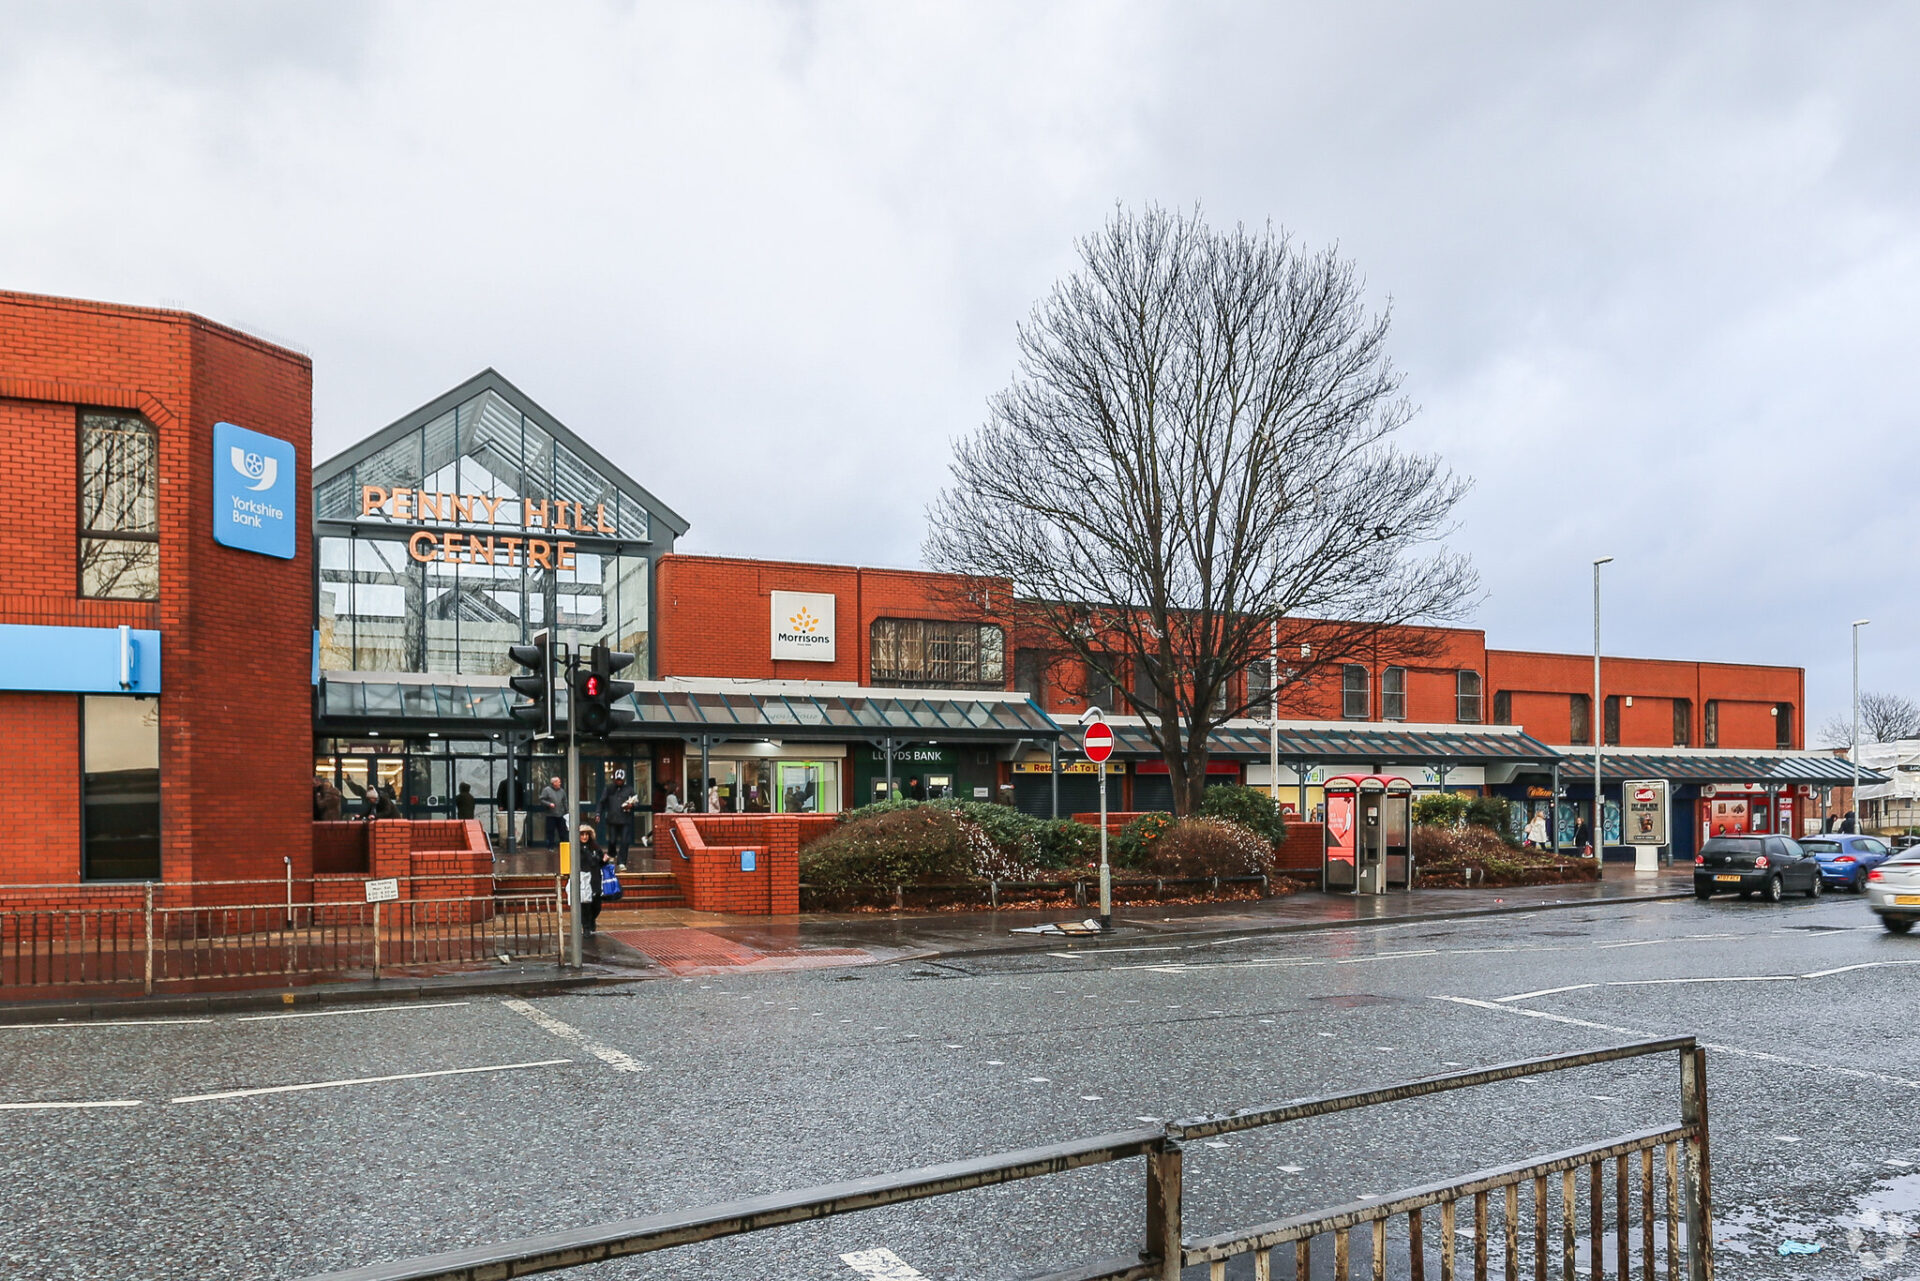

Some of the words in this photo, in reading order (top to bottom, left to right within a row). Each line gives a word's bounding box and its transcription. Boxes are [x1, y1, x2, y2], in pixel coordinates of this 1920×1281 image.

[231, 495, 283, 520] Yorkshire
[362, 485, 503, 525] PENNY
[525, 498, 616, 534] HILL
[232, 509, 263, 529] Bank
[409, 530, 577, 571] CENTRE
[778, 632, 830, 644] Morrisons
[872, 751, 911, 761] LLOYDS
[914, 751, 942, 761] BANK
[1033, 763, 1053, 772] Reta
[1080, 764, 1091, 772] To
[1425, 773, 1441, 783] we
